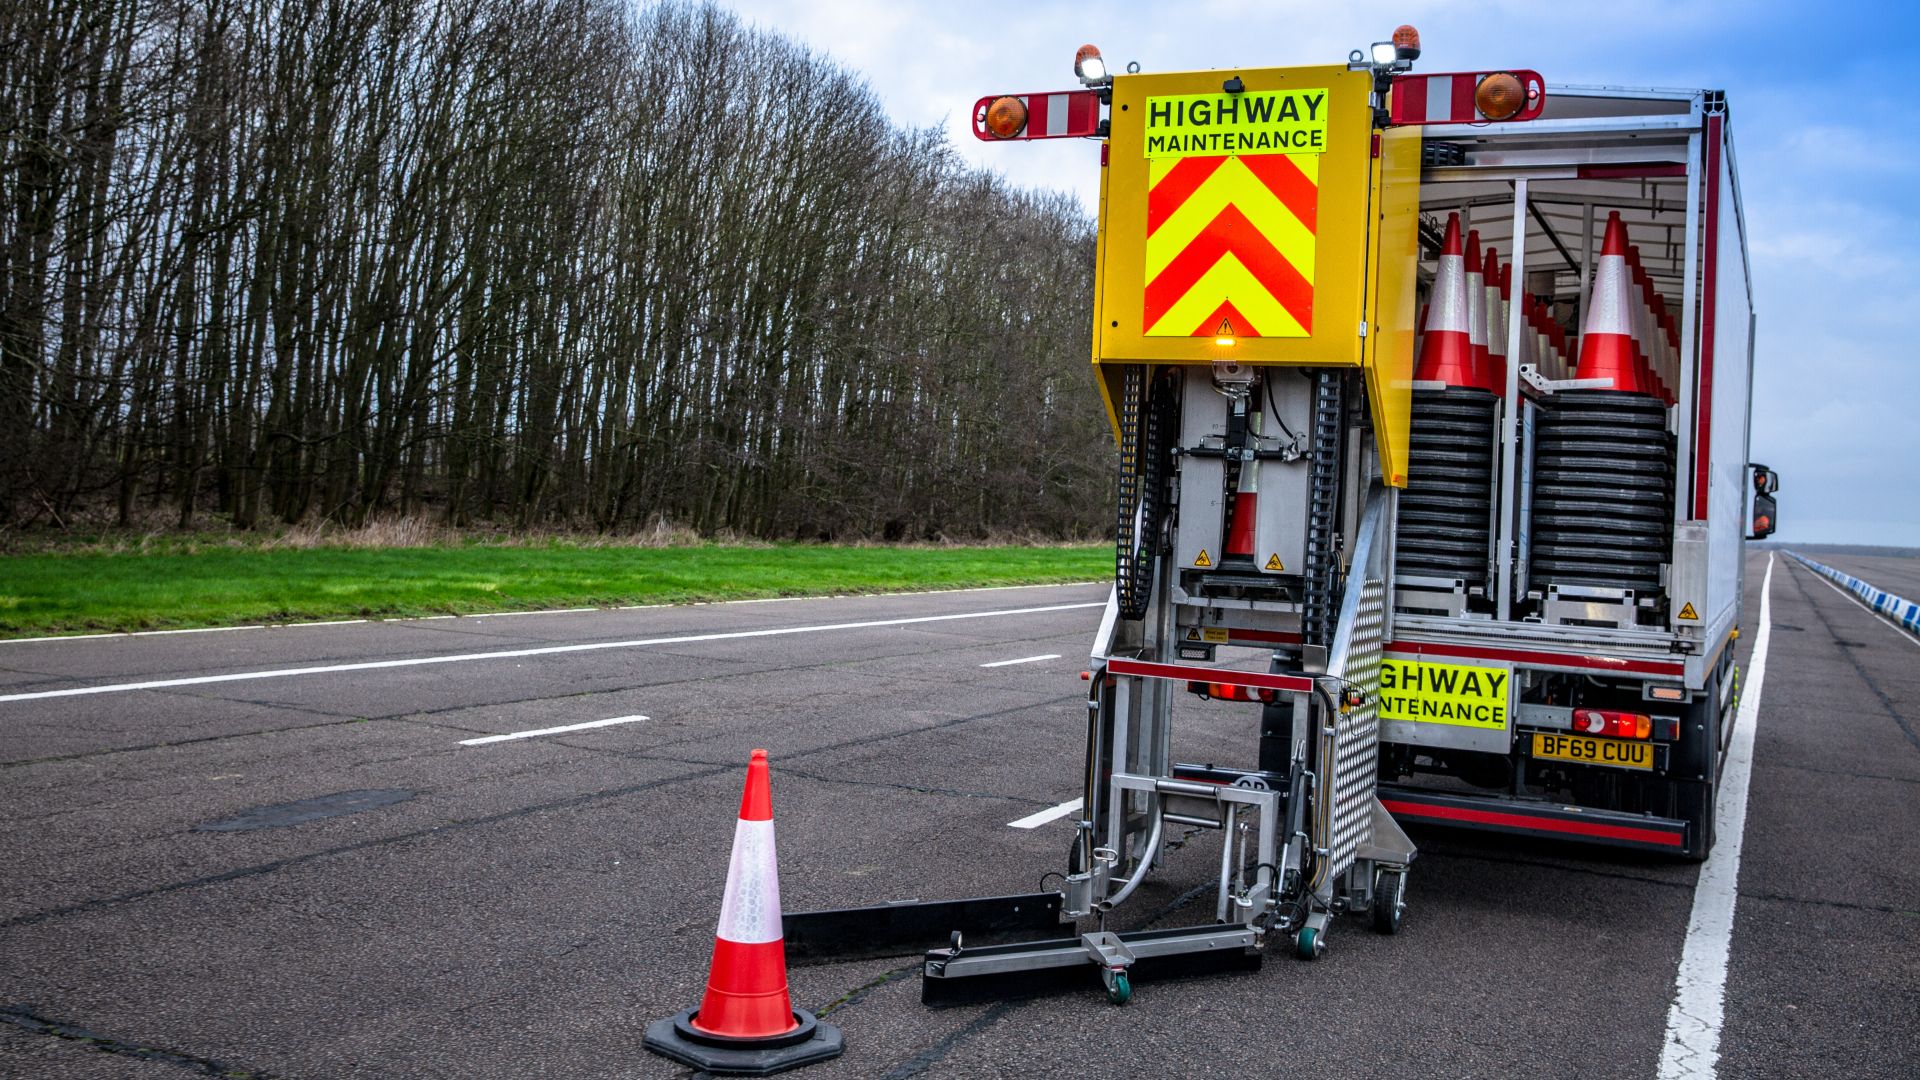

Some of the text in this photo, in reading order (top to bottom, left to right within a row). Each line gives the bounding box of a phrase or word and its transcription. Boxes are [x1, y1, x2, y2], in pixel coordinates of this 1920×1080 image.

[1150, 94, 1325, 127] HIGHWAY
[1148, 129, 1323, 153] MAINTENANCE
[1380, 663, 1506, 698] GHWAY
[1379, 695, 1504, 724] NTENANCE
[1543, 736, 1644, 763] BF69 CUU
